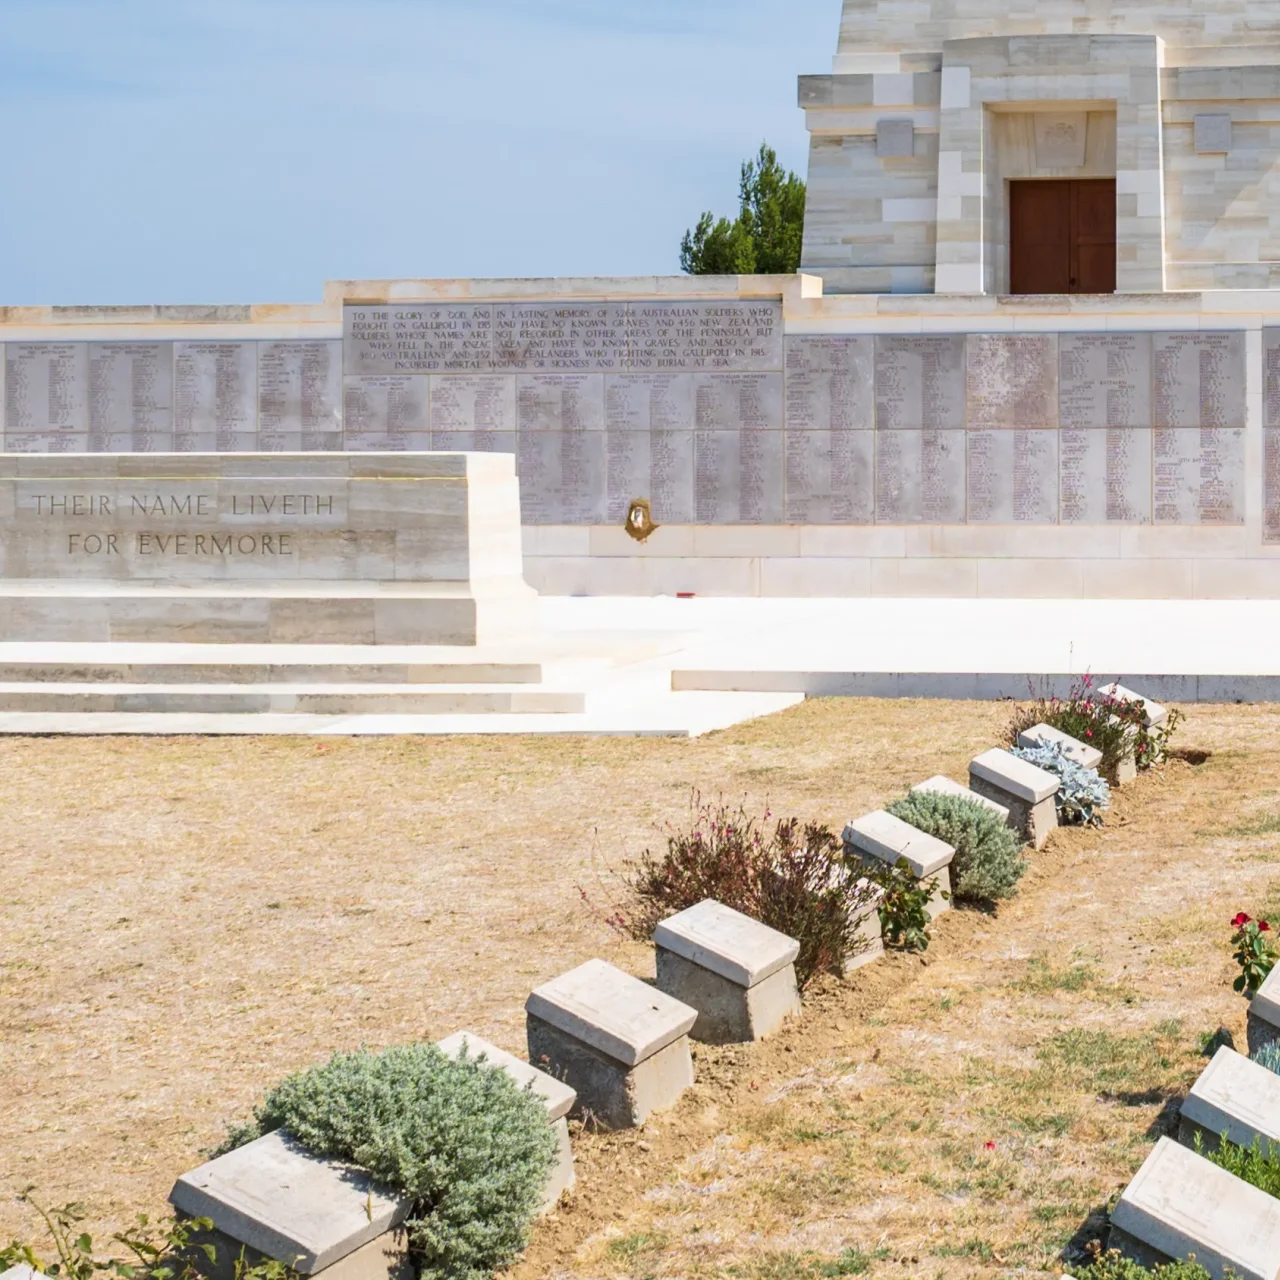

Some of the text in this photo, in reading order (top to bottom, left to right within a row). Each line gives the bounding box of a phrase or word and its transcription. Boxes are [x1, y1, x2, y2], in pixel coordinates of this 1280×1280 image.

[352, 312, 365, 320] TO
[372, 312, 388, 320] THE
[395, 312, 423, 320] GLORY
[430, 311, 441, 319] OF
[448, 311, 466, 319] GOD
[472, 311, 490, 319] AND
[497, 310, 506, 318] IN
[512, 310, 549, 318] LASTING
[554, 310, 591, 318] MEMORY
[597, 310, 608, 318] OF
[641, 308, 699, 317] AUSTRALIAN
[705, 308, 743, 316] SOLDIERS
[749, 308, 773, 316] WHO
[352, 322, 387, 330] FOUGHT
[393, 321, 406, 329] ON
[412, 321, 457, 329] GALLIPOLI
[462, 321, 471, 329] IN
[497, 320, 516, 328] AND
[521, 320, 548, 328] HAVE
[552, 320, 566, 328] NO
[571, 320, 607, 328] KNOWN
[612, 319, 649, 327] GRAVES
[655, 318, 674, 327] AND
[699, 318, 721, 326] NEW
[728, 318, 773, 326] ZEALAND
[352, 328, 773, 340] SOLDIERS WHOSE NAMES ARE NOT RECORDED IN OTHER AREAS OF THE PENINSULA BUT
[369, 341, 392, 350] WHO
[398, 341, 417, 349] FELL
[424, 341, 433, 349] IN
[439, 341, 455, 349] THE
[462, 340, 491, 349] ANZAC
[498, 340, 521, 348] AREA
[528, 340, 546, 348] AND
[552, 340, 576, 348] HAVE
[583, 340, 596, 348] NO
[602, 339, 638, 348] KNOWN
[687, 339, 707, 347] AND
[713, 338, 737, 347] ALSO
[743, 338, 754, 346] OF
[381, 351, 446, 360] AUSTRALIANS
[452, 351, 470, 359] AND
[475, 351, 491, 359] 252
[496, 350, 517, 358] NEW
[523, 350, 579, 358] ZEALANDERS
[585, 350, 607, 358] WHO
[613, 349, 656, 358] FIGHTING
[662, 349, 676, 357] ON
[682, 349, 729, 357] GALLIPOLI
[735, 349, 745, 357] IN
[395, 361, 439, 369] INCURRED
[444, 360, 481, 369] MORTAL
[488, 360, 527, 368] WOUNDS
[533, 360, 545, 368] OR
[551, 360, 589, 368] SICKNESS
[595, 360, 614, 368] AND
[620, 360, 651, 368] FOUND
[657, 359, 685, 367] BURIAL
[693, 359, 706, 367] AT
[32, 495, 334, 516] THEIR NAME LIVETH
[68, 534, 293, 556] FOR EVERMORE
